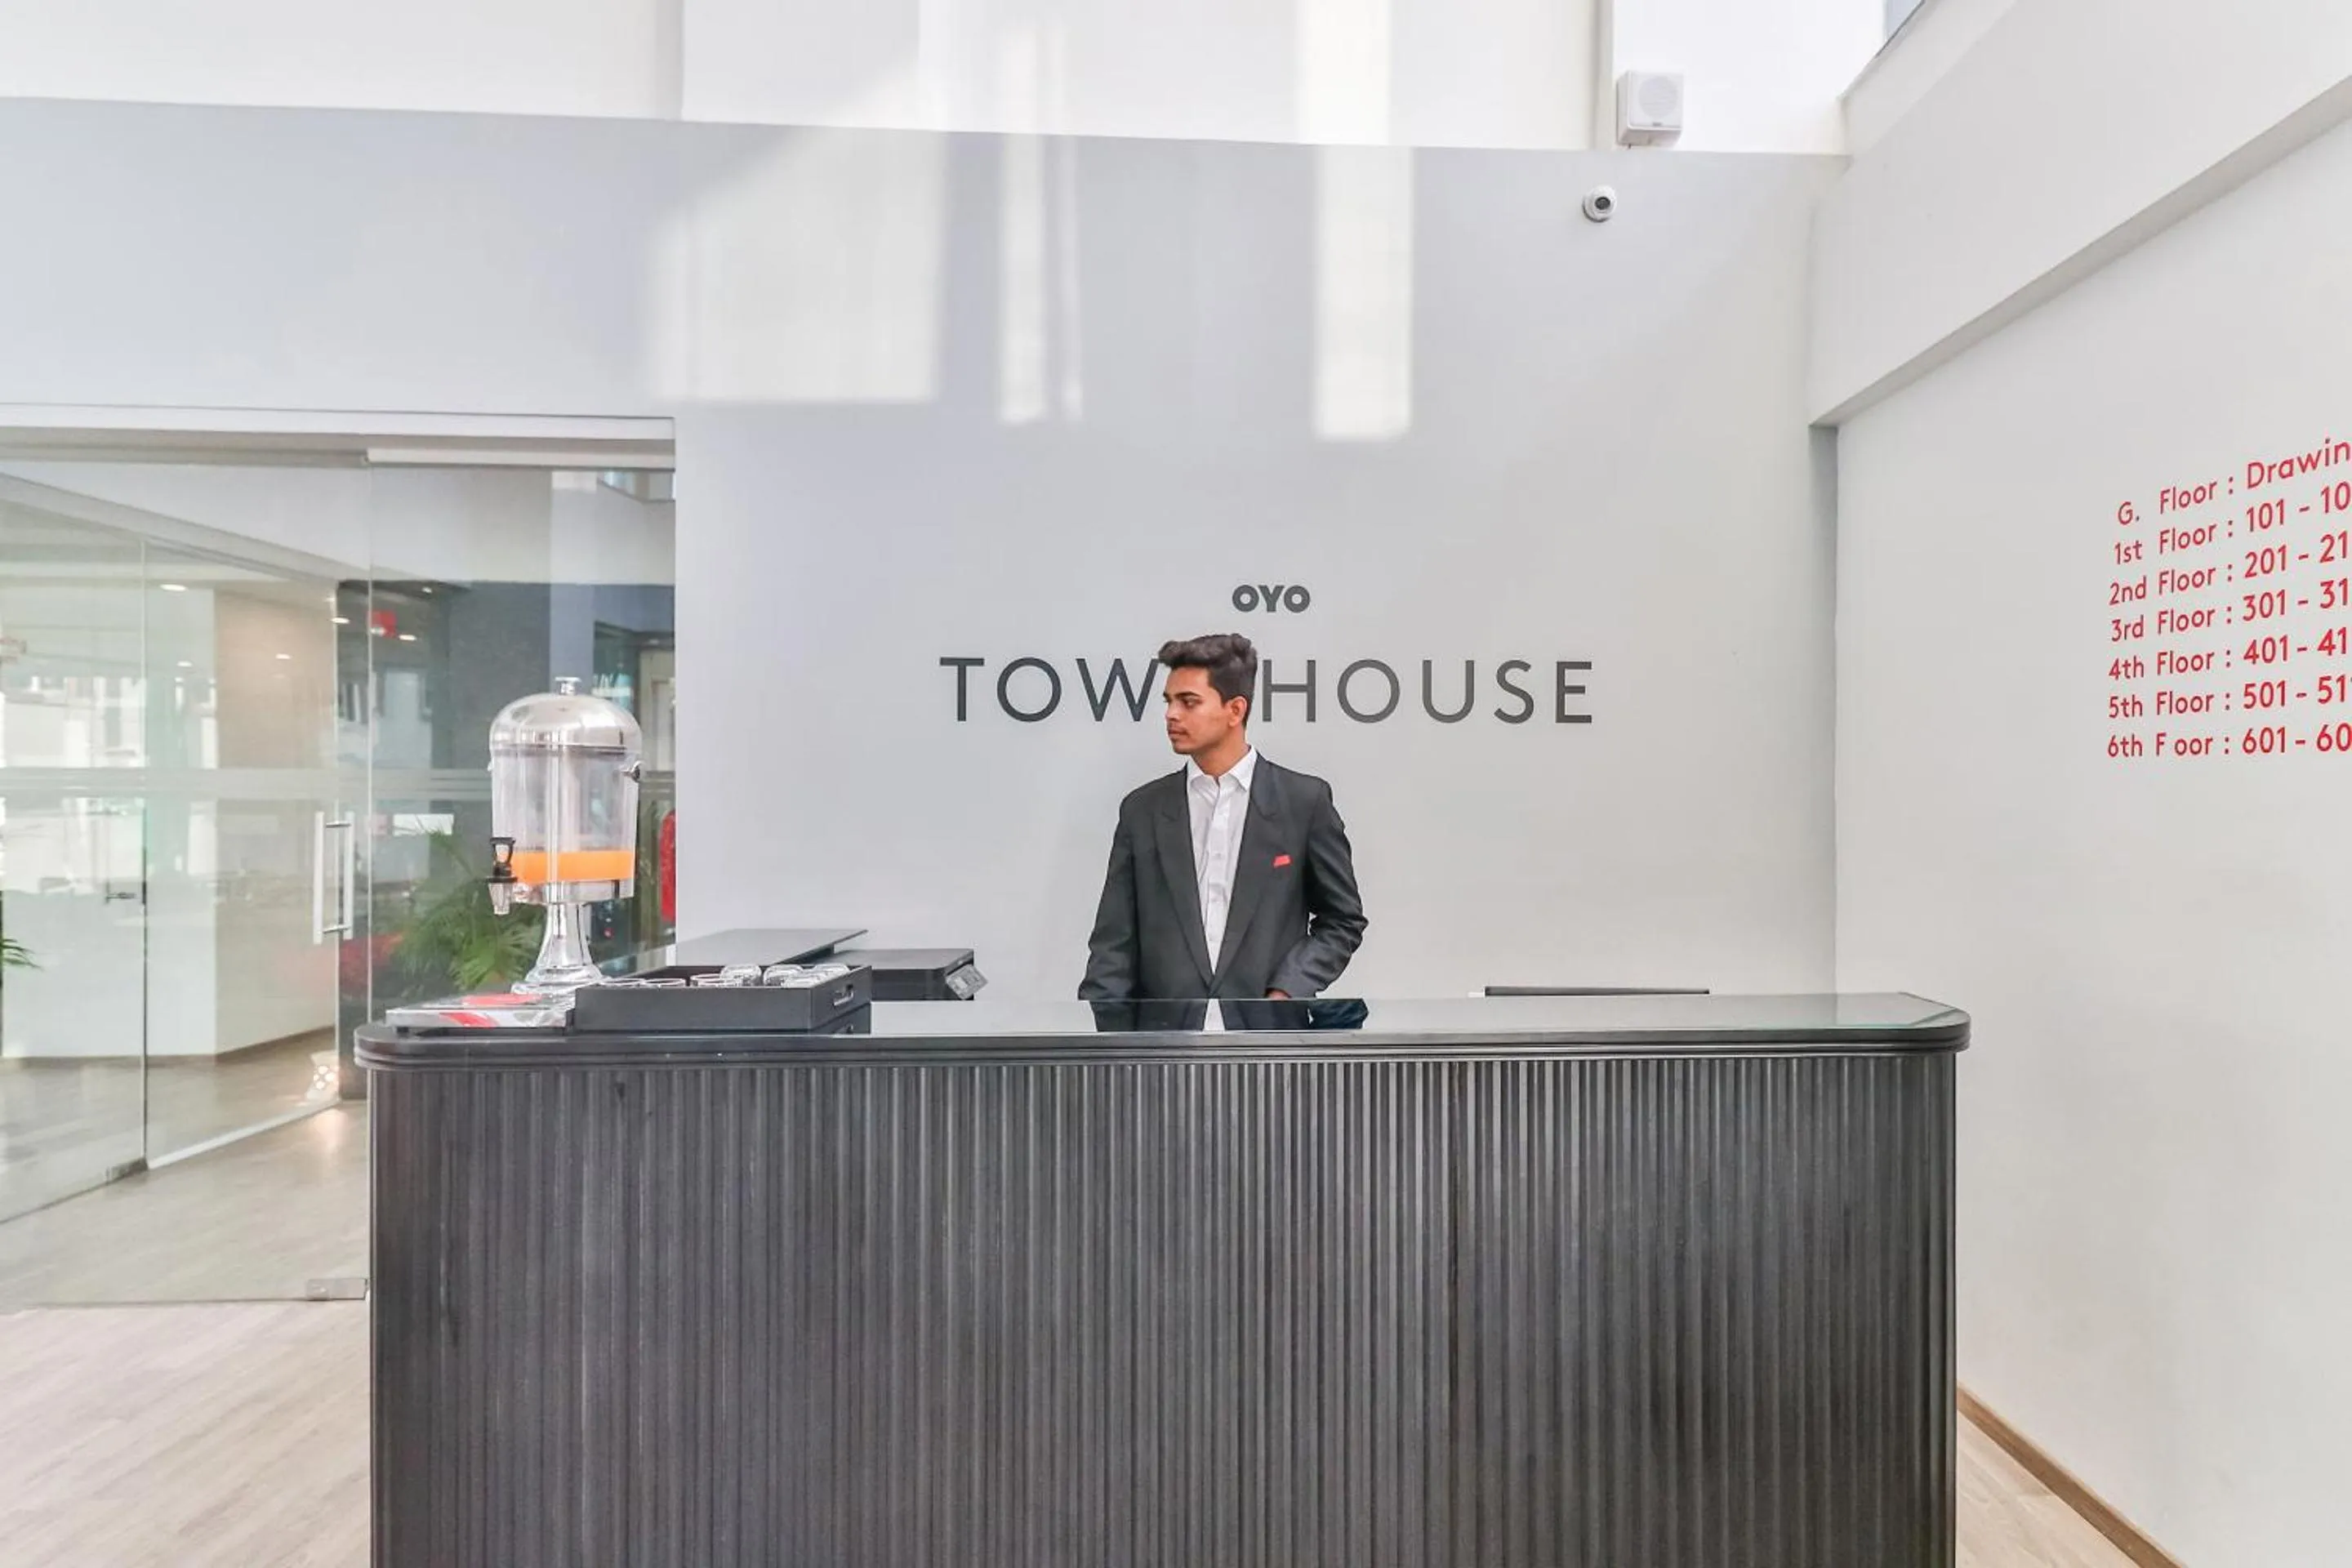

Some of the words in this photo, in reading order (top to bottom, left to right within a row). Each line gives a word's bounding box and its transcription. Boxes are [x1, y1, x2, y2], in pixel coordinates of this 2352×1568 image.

[2117, 501, 2141, 527] G.
[2159, 480, 2217, 514] Floor
[2246, 437, 2351, 490] Drawin
[2115, 539, 2143, 565] 1st
[2158, 522, 2216, 555] Floor
[2246, 498, 2286, 532] 101
[2320, 480, 2351, 514] 10
[1232, 584, 1311, 613] OYO
[2109, 576, 2148, 606] 2nd
[2158, 566, 2216, 596] Floor
[2244, 543, 2287, 580] 201
[2319, 530, 2349, 564] 21
[2110, 614, 2145, 643] 3rd
[2157, 608, 2216, 635] Floor
[2242, 589, 2287, 622] 301
[2319, 577, 2349, 610] 31
[2109, 655, 2145, 680] 4th
[2156, 649, 2216, 676] Floor
[2243, 634, 2289, 666] 401
[2317, 626, 2347, 657] 41
[939, 657, 1592, 724] TOWHOUSE
[2109, 694, 2144, 719] 5th
[2156, 690, 2215, 716] Floor
[2243, 679, 2287, 710] 501
[2317, 674, 2352, 706] 51
[2108, 733, 2144, 758] 6th
[2242, 725, 2287, 755] 601
[2316, 722, 2352, 753] 60
